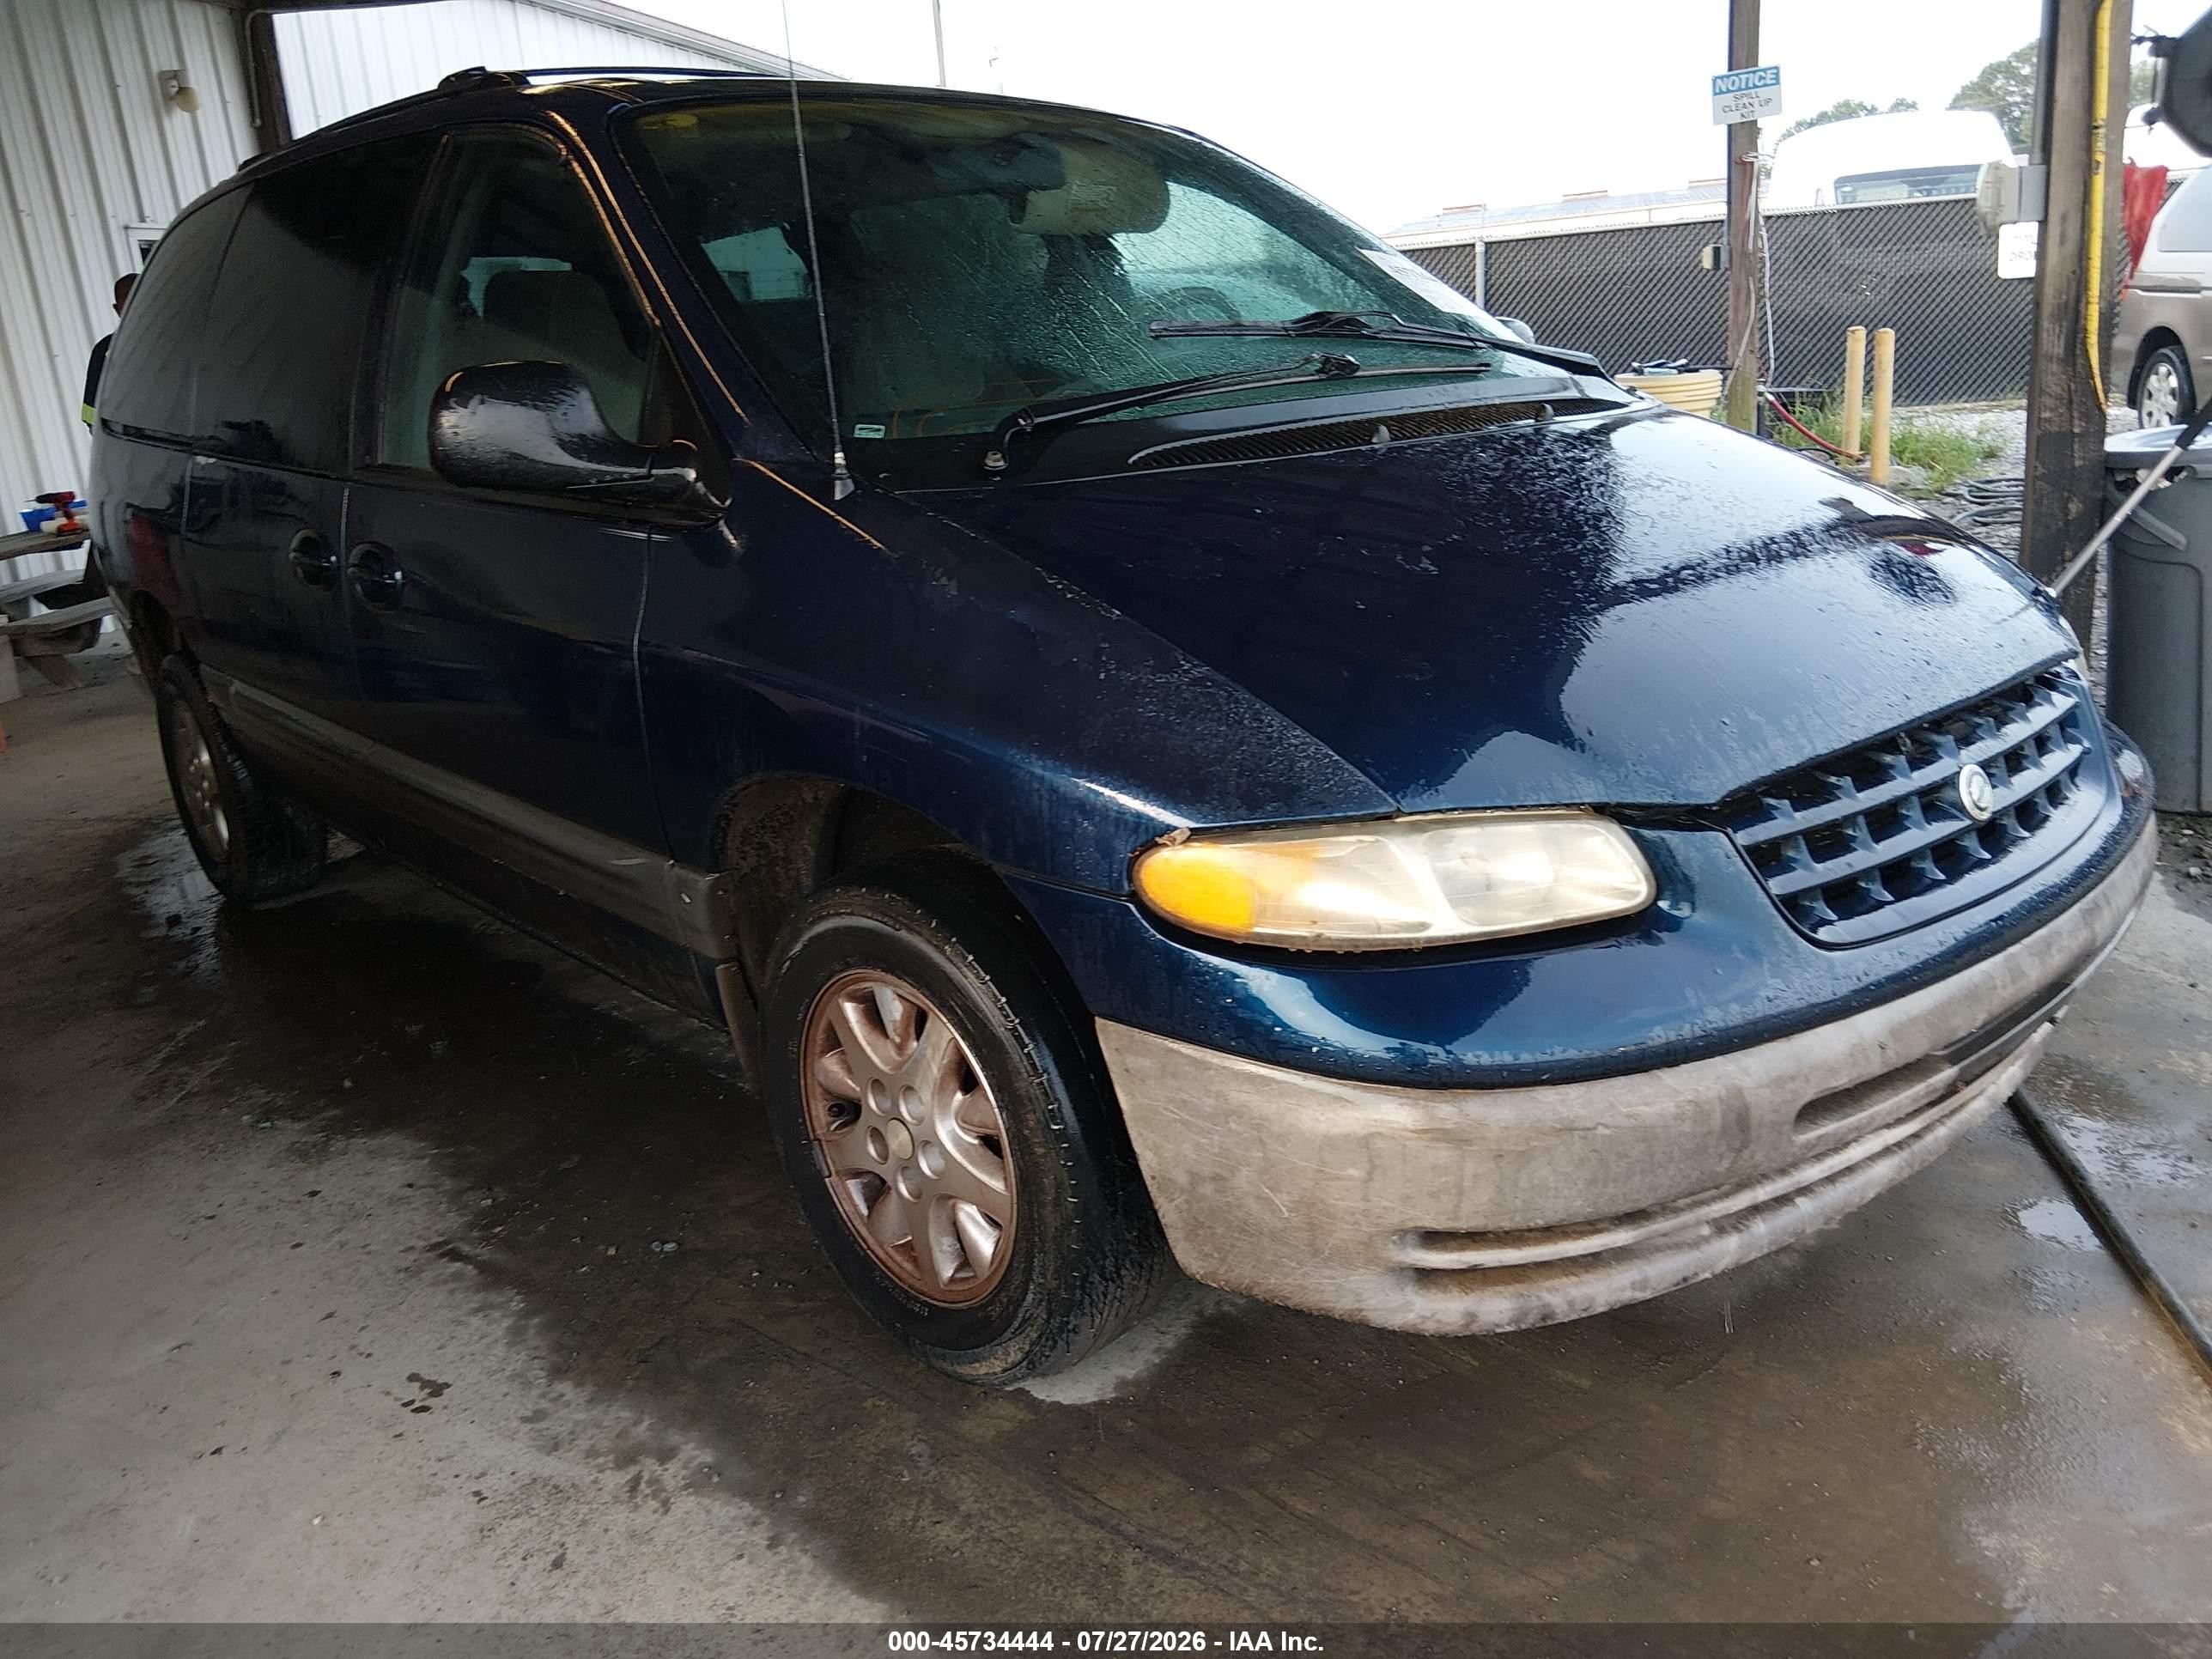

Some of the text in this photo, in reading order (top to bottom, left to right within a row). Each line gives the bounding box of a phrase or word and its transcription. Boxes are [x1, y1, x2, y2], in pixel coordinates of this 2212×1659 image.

[1715, 69, 1778, 93] NOTICE
[1733, 91, 1759, 101] SPILL
[1722, 98, 1772, 113] CLEAN UP
[1740, 110, 1757, 119] KIT
